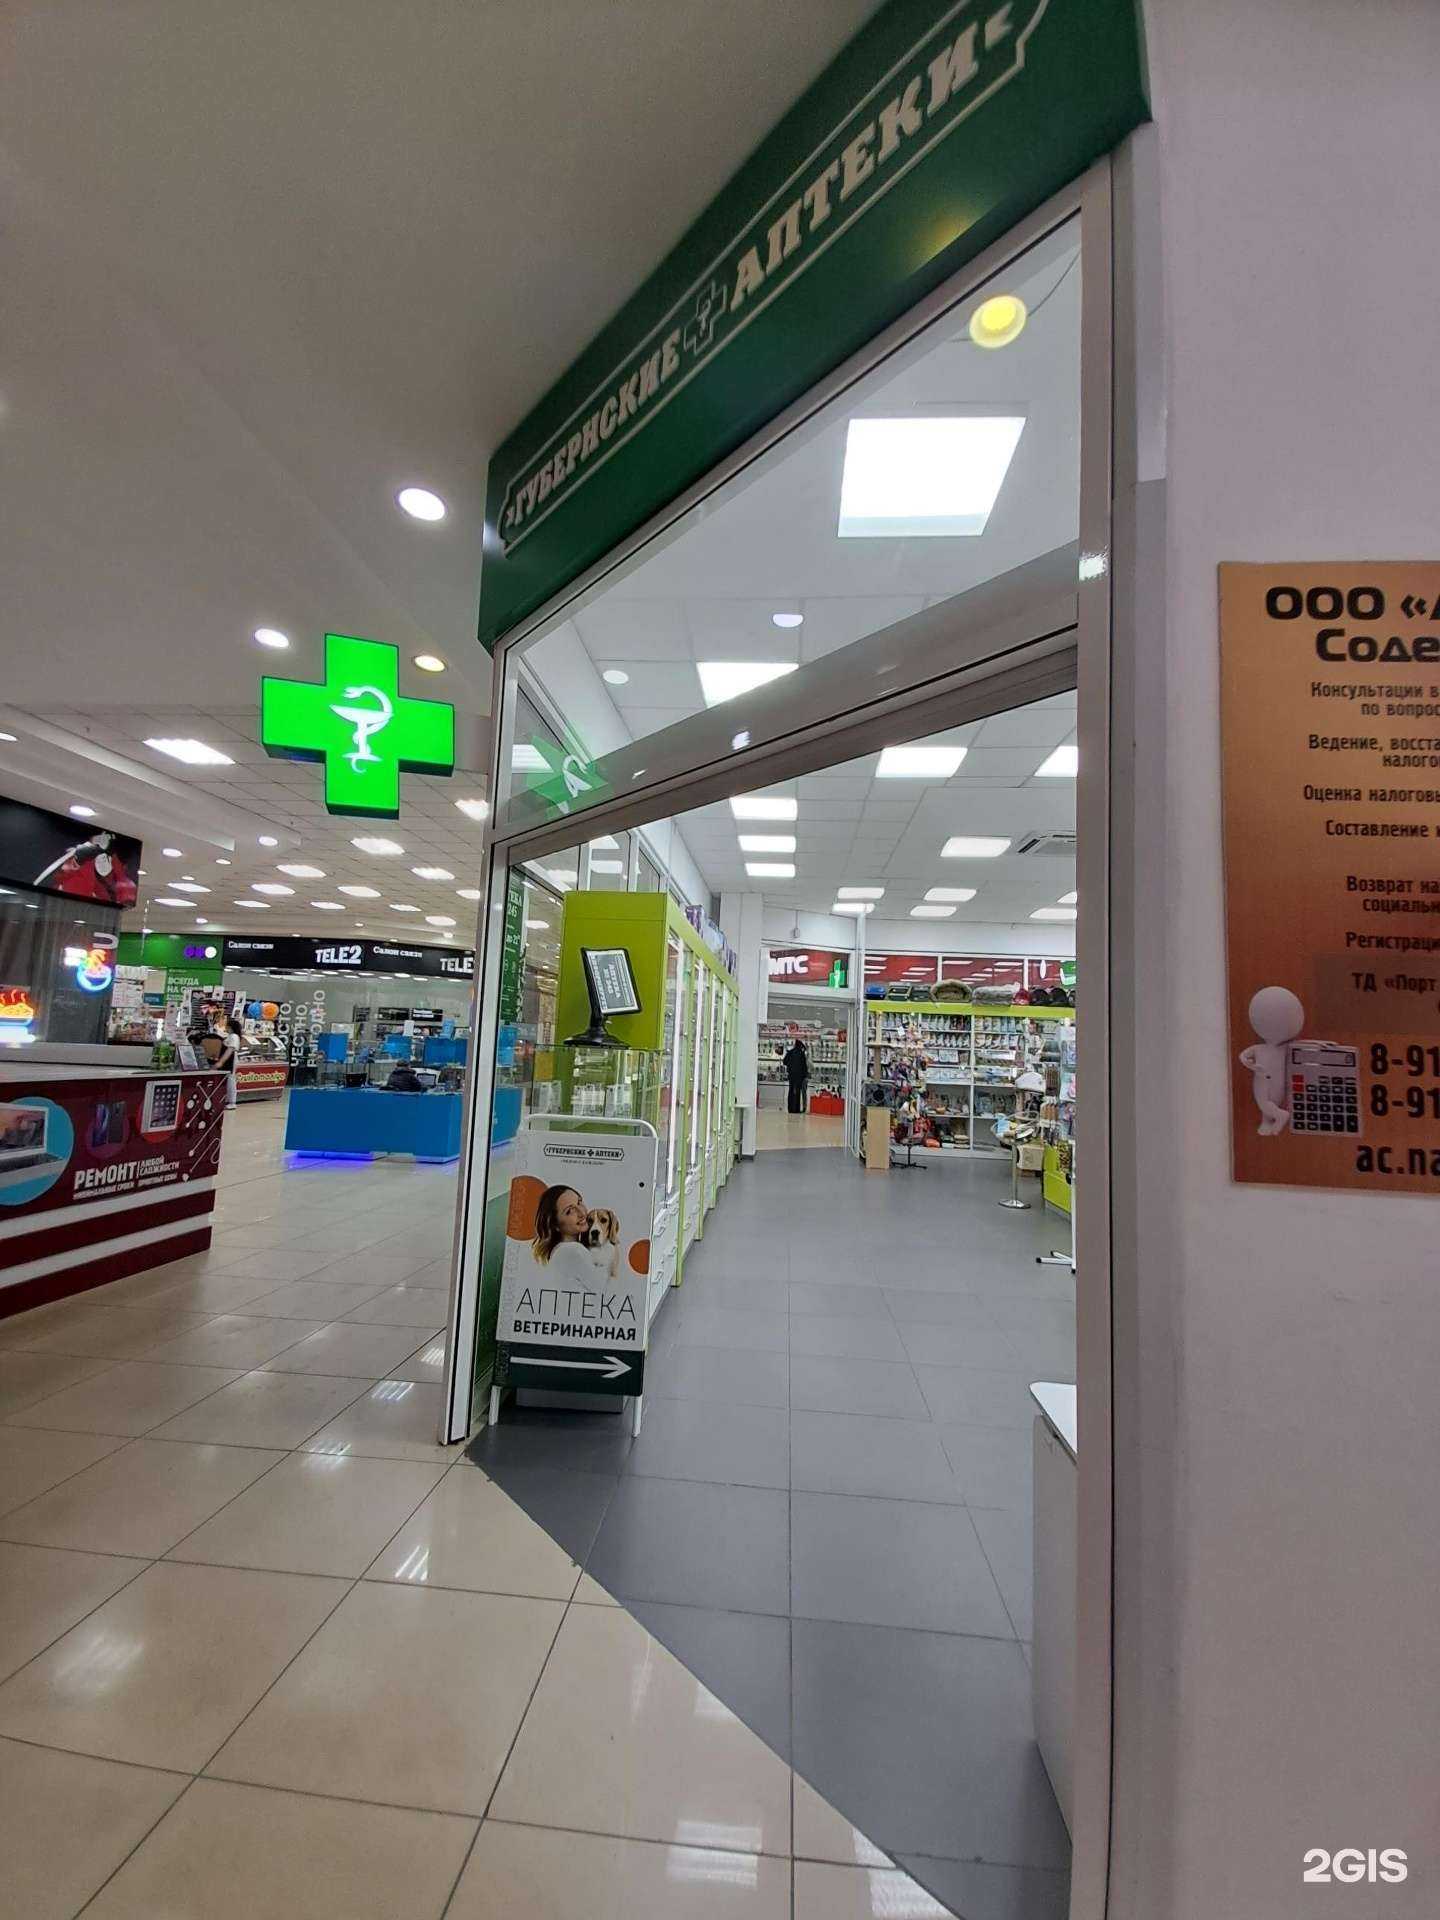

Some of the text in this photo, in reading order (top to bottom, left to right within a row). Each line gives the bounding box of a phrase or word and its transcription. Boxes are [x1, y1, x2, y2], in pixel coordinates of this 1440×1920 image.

[512, 22, 981, 523] ГУБЕРНСКИЕ АПТЕКИ
[1266, 586, 1385, 621] ООО
[1316, 628, 1440, 662] Соде
[1311, 682, 1424, 700] Консультации
[1361, 704, 1440, 719] по вопрос
[1308, 734, 1440, 751] Ведение, восста
[1382, 755, 1440, 768] налого
[1303, 784, 1362, 802] Оценка
[1325, 820, 1429, 838] Составление
[1347, 876, 1413, 895] Возврат
[315, 945, 362, 964] TELE2
[1352, 972, 1377, 992] ТД
[73, 1161, 138, 1190] РЕМОНТ
[515, 1287, 636, 1321] АПТЕКА
[513, 1319, 637, 1341] ВЕТЕРИНАРНАЯ
